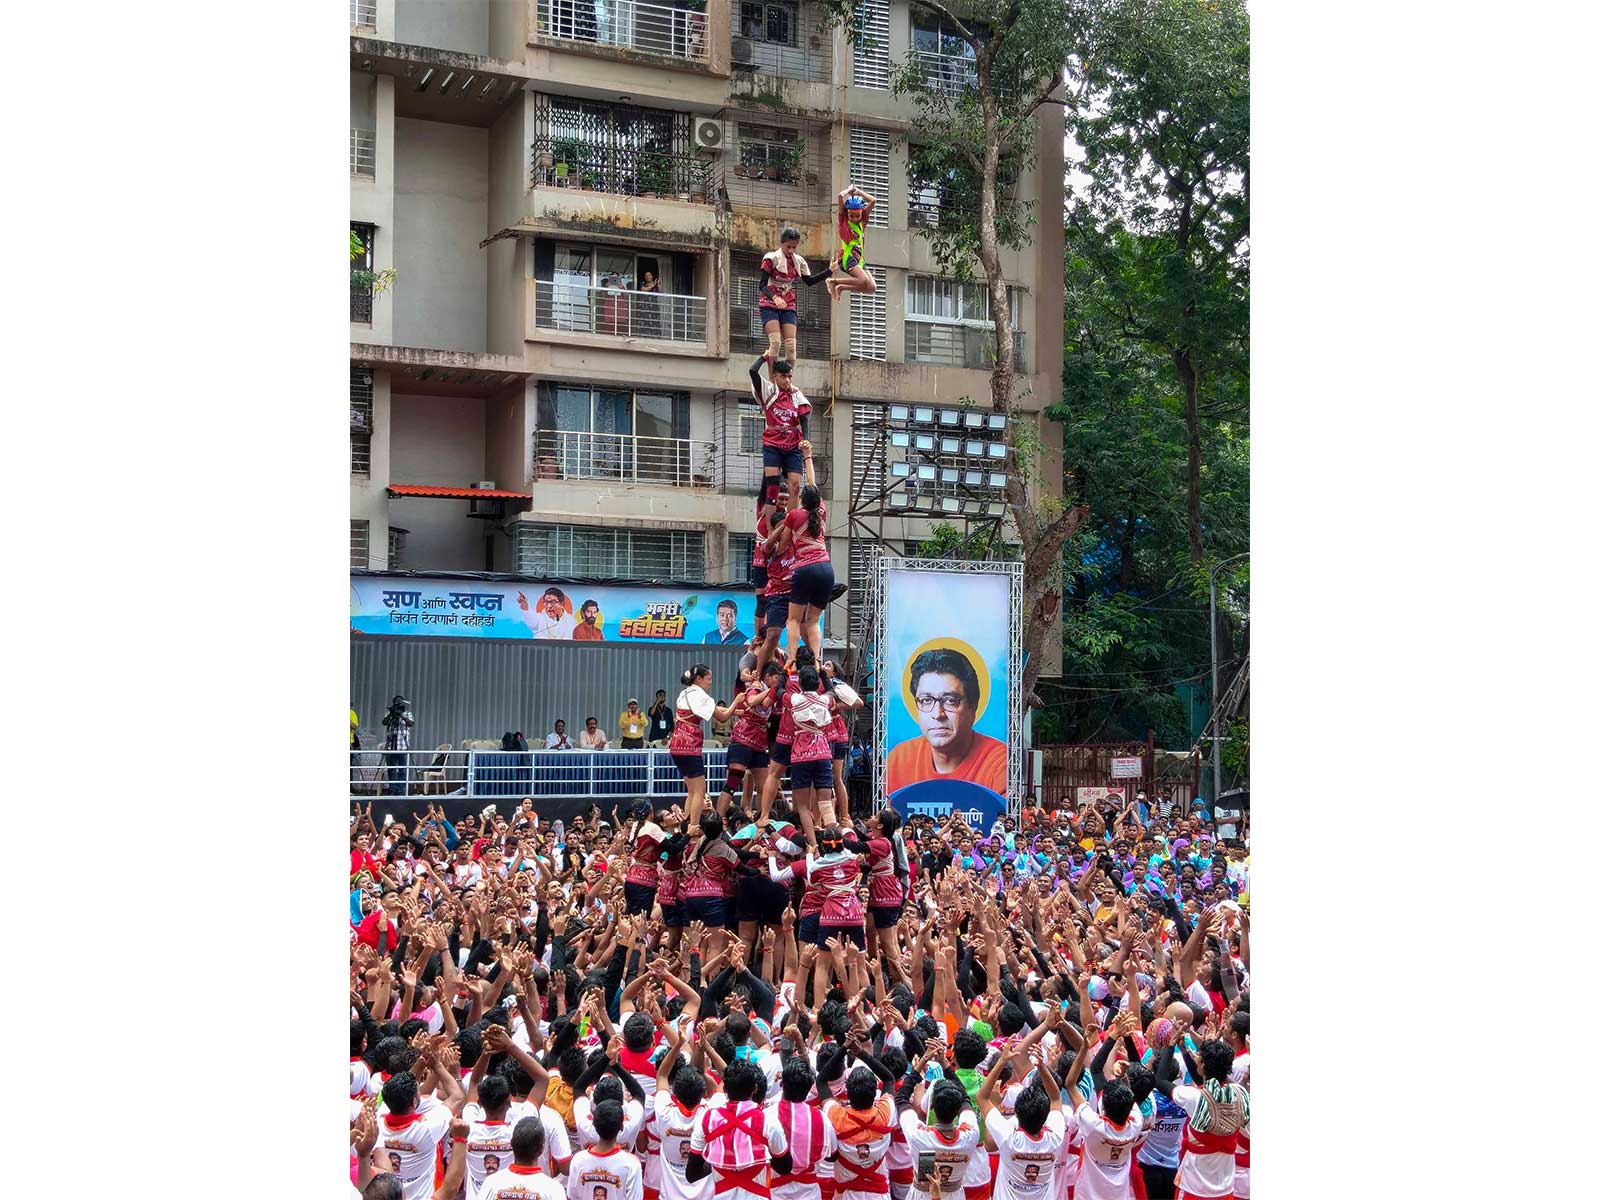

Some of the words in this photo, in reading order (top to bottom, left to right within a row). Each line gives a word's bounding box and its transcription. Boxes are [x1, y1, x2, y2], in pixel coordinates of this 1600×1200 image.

[383, 590, 421, 609] सण
[422, 597, 446, 609] आणि
[449, 592, 504, 611] स्वप्न
[389, 611, 418, 624] जिवंत
[421, 611, 458, 626] ठेवणारी
[461, 613, 495, 627] दहीहंडी
[620, 614, 686, 638] दहीहंडी
